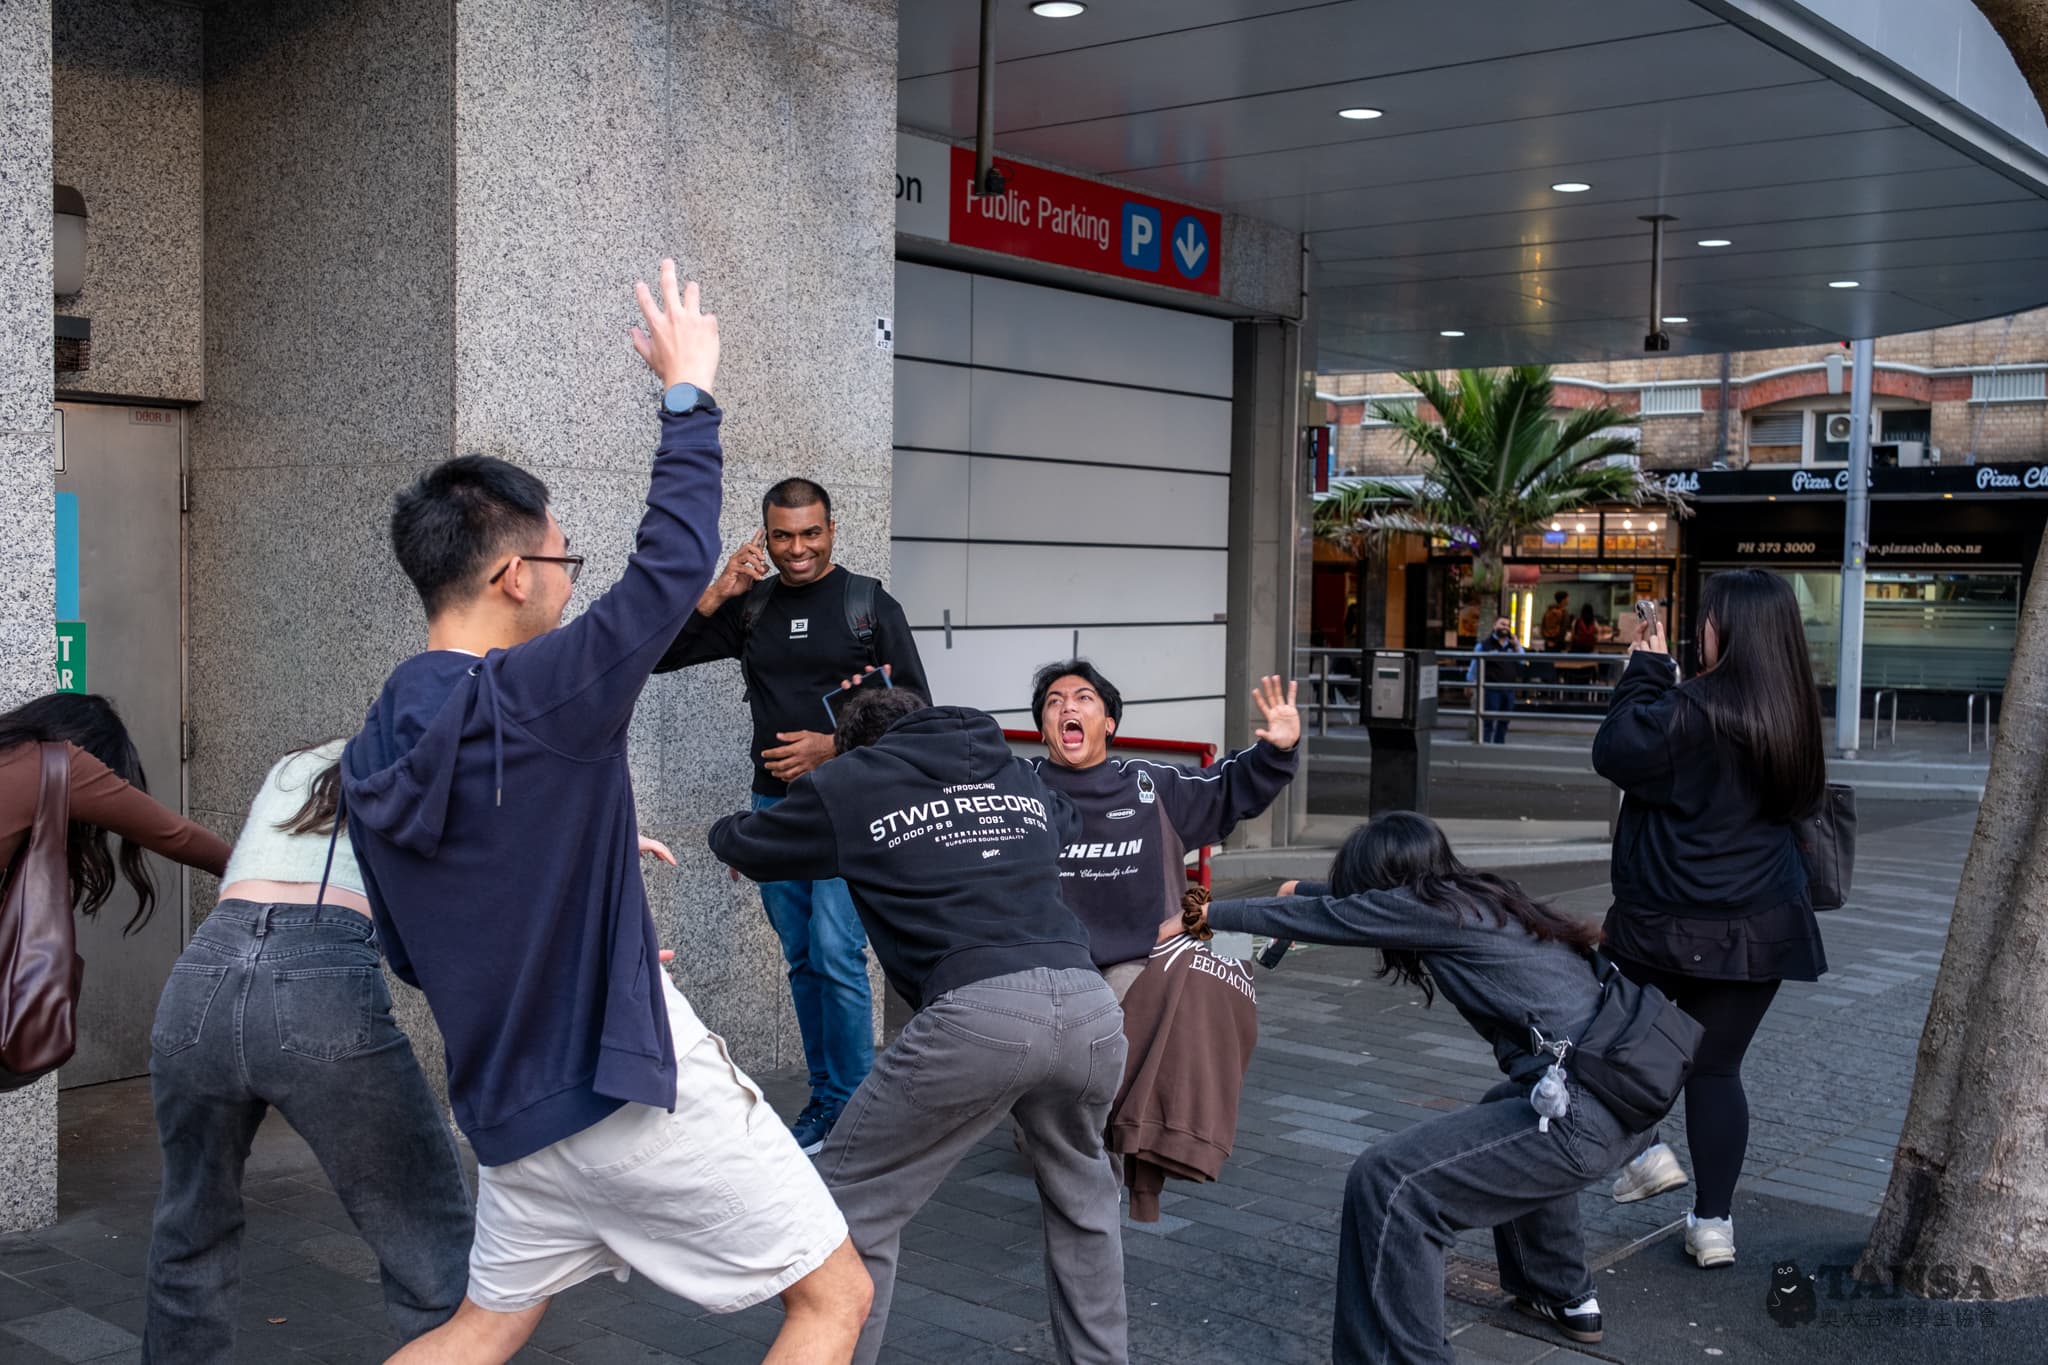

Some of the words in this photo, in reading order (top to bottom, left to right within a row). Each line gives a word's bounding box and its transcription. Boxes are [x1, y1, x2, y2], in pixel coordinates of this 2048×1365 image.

[966, 179, 1030, 227] Public
[1038, 196, 1110, 251] Parking
[1131, 214, 1153, 257] P
[1791, 471, 1832, 492] Pizza
[1976, 467, 2020, 490] Pizza
[1737, 542, 1755, 553] PH
[1757, 542, 1781, 553] 373
[1784, 542, 1816, 553] 3000
[943, 782, 996, 795] INTRODUCING
[869, 799, 950, 842] STWD
[954, 794, 1048, 823] RECORDS
[934, 828, 1012, 843] ENTERTAINMENT
[945, 838, 977, 848] SUPERIOR
[1000, 834, 1024, 842] QUALITY
[1189, 954, 1226, 980] EELO
